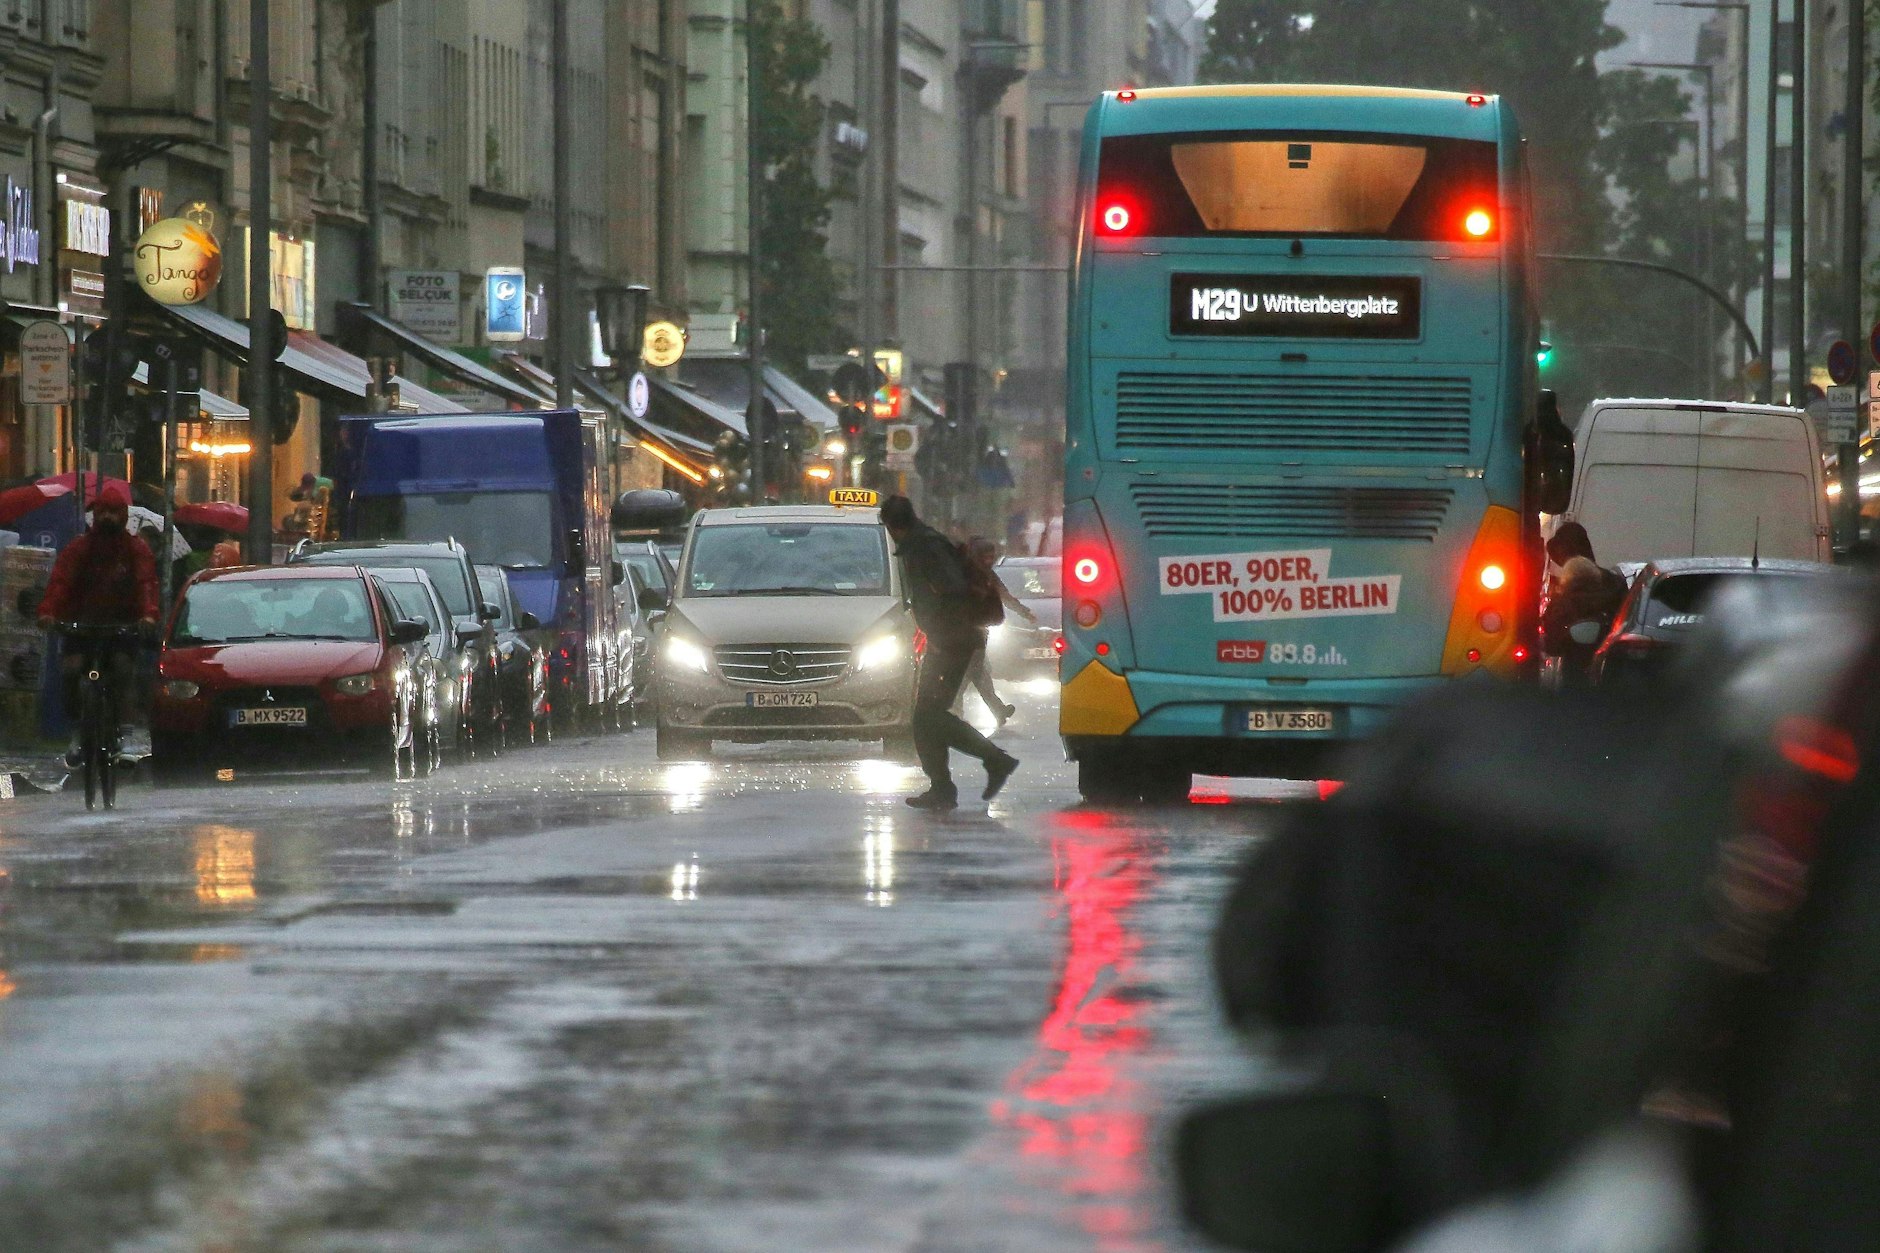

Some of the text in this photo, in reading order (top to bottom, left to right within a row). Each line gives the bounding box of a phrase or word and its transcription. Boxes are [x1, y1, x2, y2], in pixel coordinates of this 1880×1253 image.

[136, 239, 209, 301] Tango
[406, 276, 444, 286] FOTO
[1191, 288, 1399, 321] M29 U Wittenbergplatz
[837, 491, 868, 502] TAXI
[1167, 557, 1319, 588] 80ER, 90ER,
[1219, 583, 1389, 615] 100% BERLIN
[1221, 645, 1260, 659] rbb
[758, 694, 766, 705] B
[238, 710, 246, 723] B
[1255, 713, 1326, 728] B V 3580
